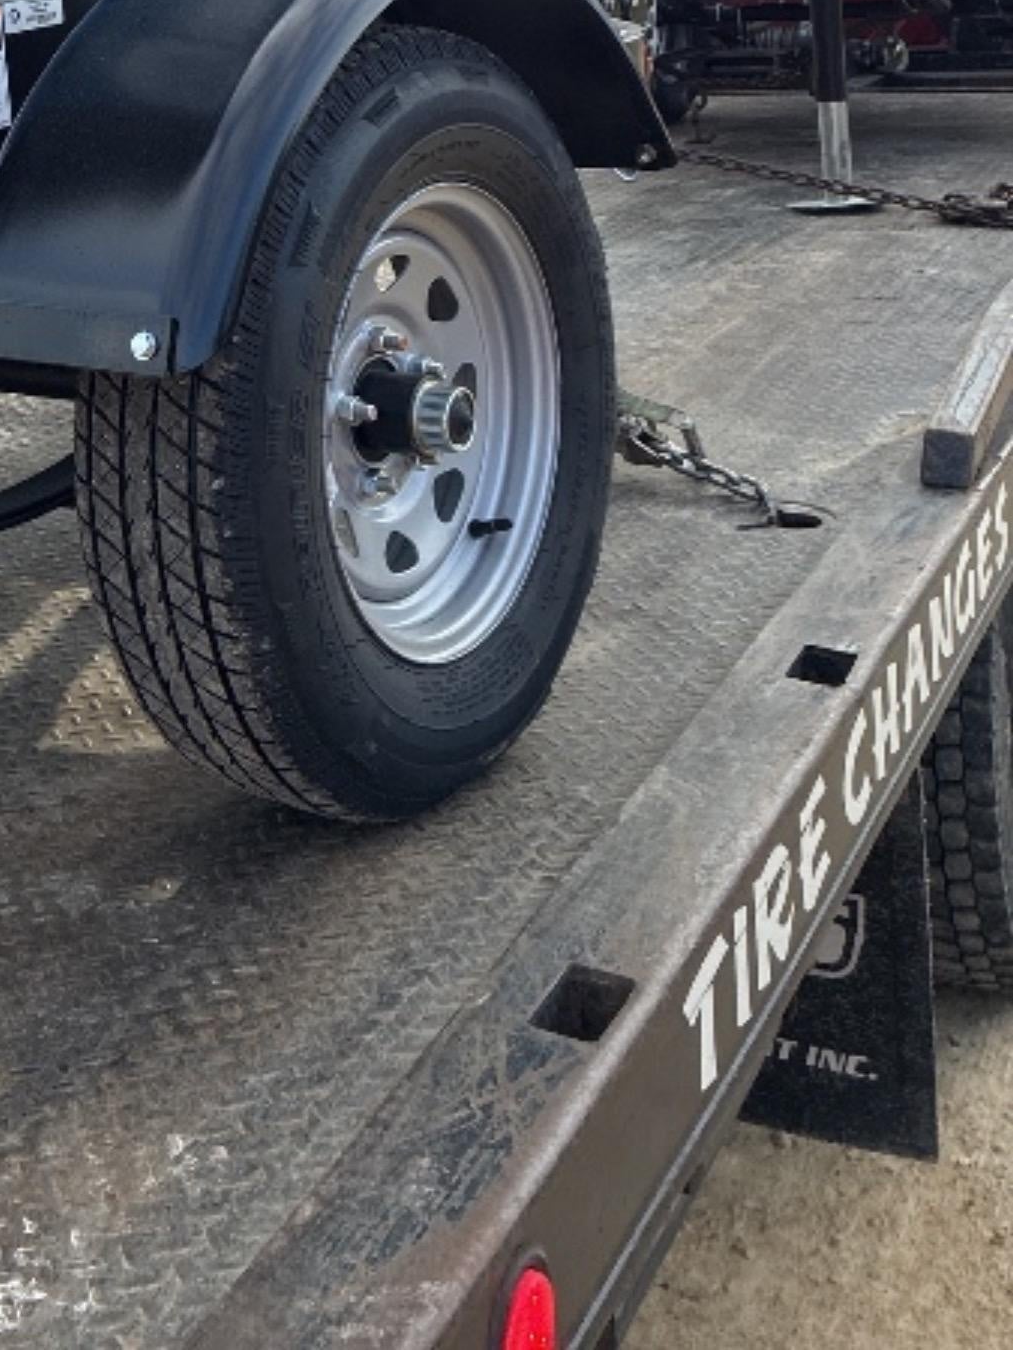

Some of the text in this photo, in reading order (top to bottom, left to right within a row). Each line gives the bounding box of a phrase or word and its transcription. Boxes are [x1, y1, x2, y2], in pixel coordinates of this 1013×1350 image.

[683, 481, 1010, 1092] TIRE CHANGES
[806, 1045, 879, 1081] INC.
